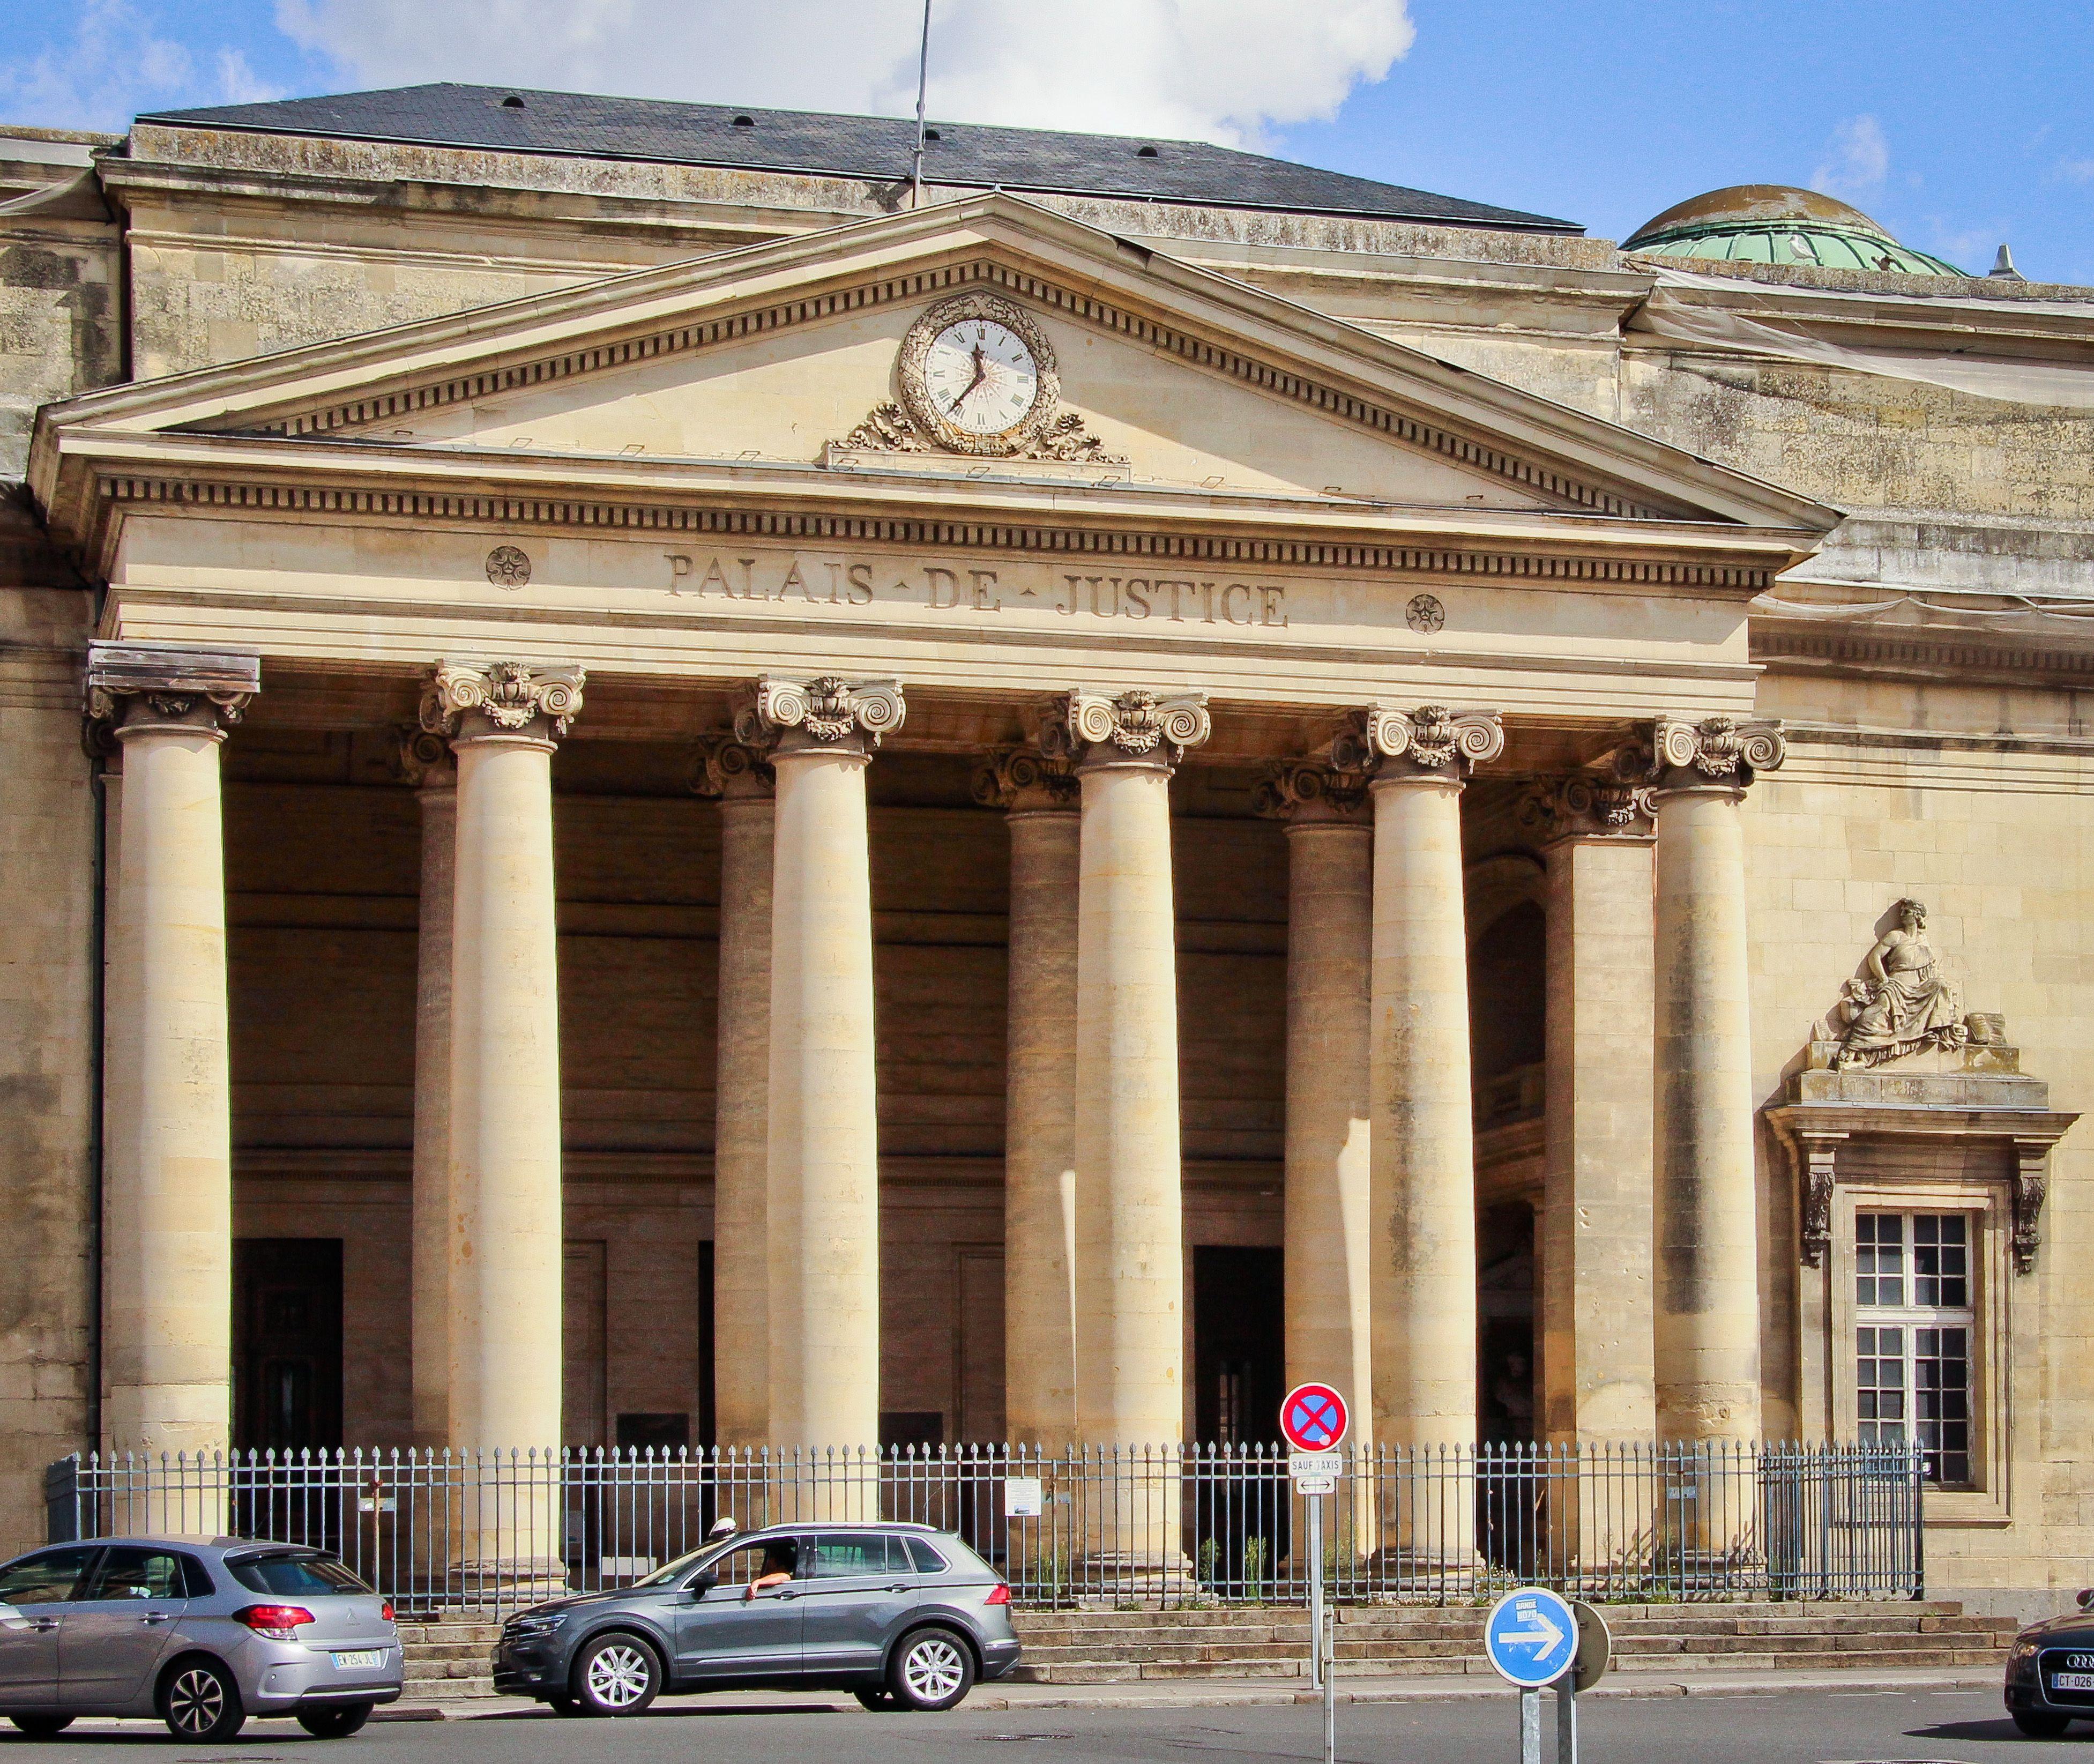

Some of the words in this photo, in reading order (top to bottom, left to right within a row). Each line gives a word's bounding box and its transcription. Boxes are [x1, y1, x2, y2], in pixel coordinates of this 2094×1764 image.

[662, 553, 874, 606] PALAIS
[922, 567, 1002, 612] DE
[1055, 574, 1288, 628] JUSTICE
[1292, 1461, 1313, 1471] SAUF
[1316, 1461, 1339, 1471] TAXIS
